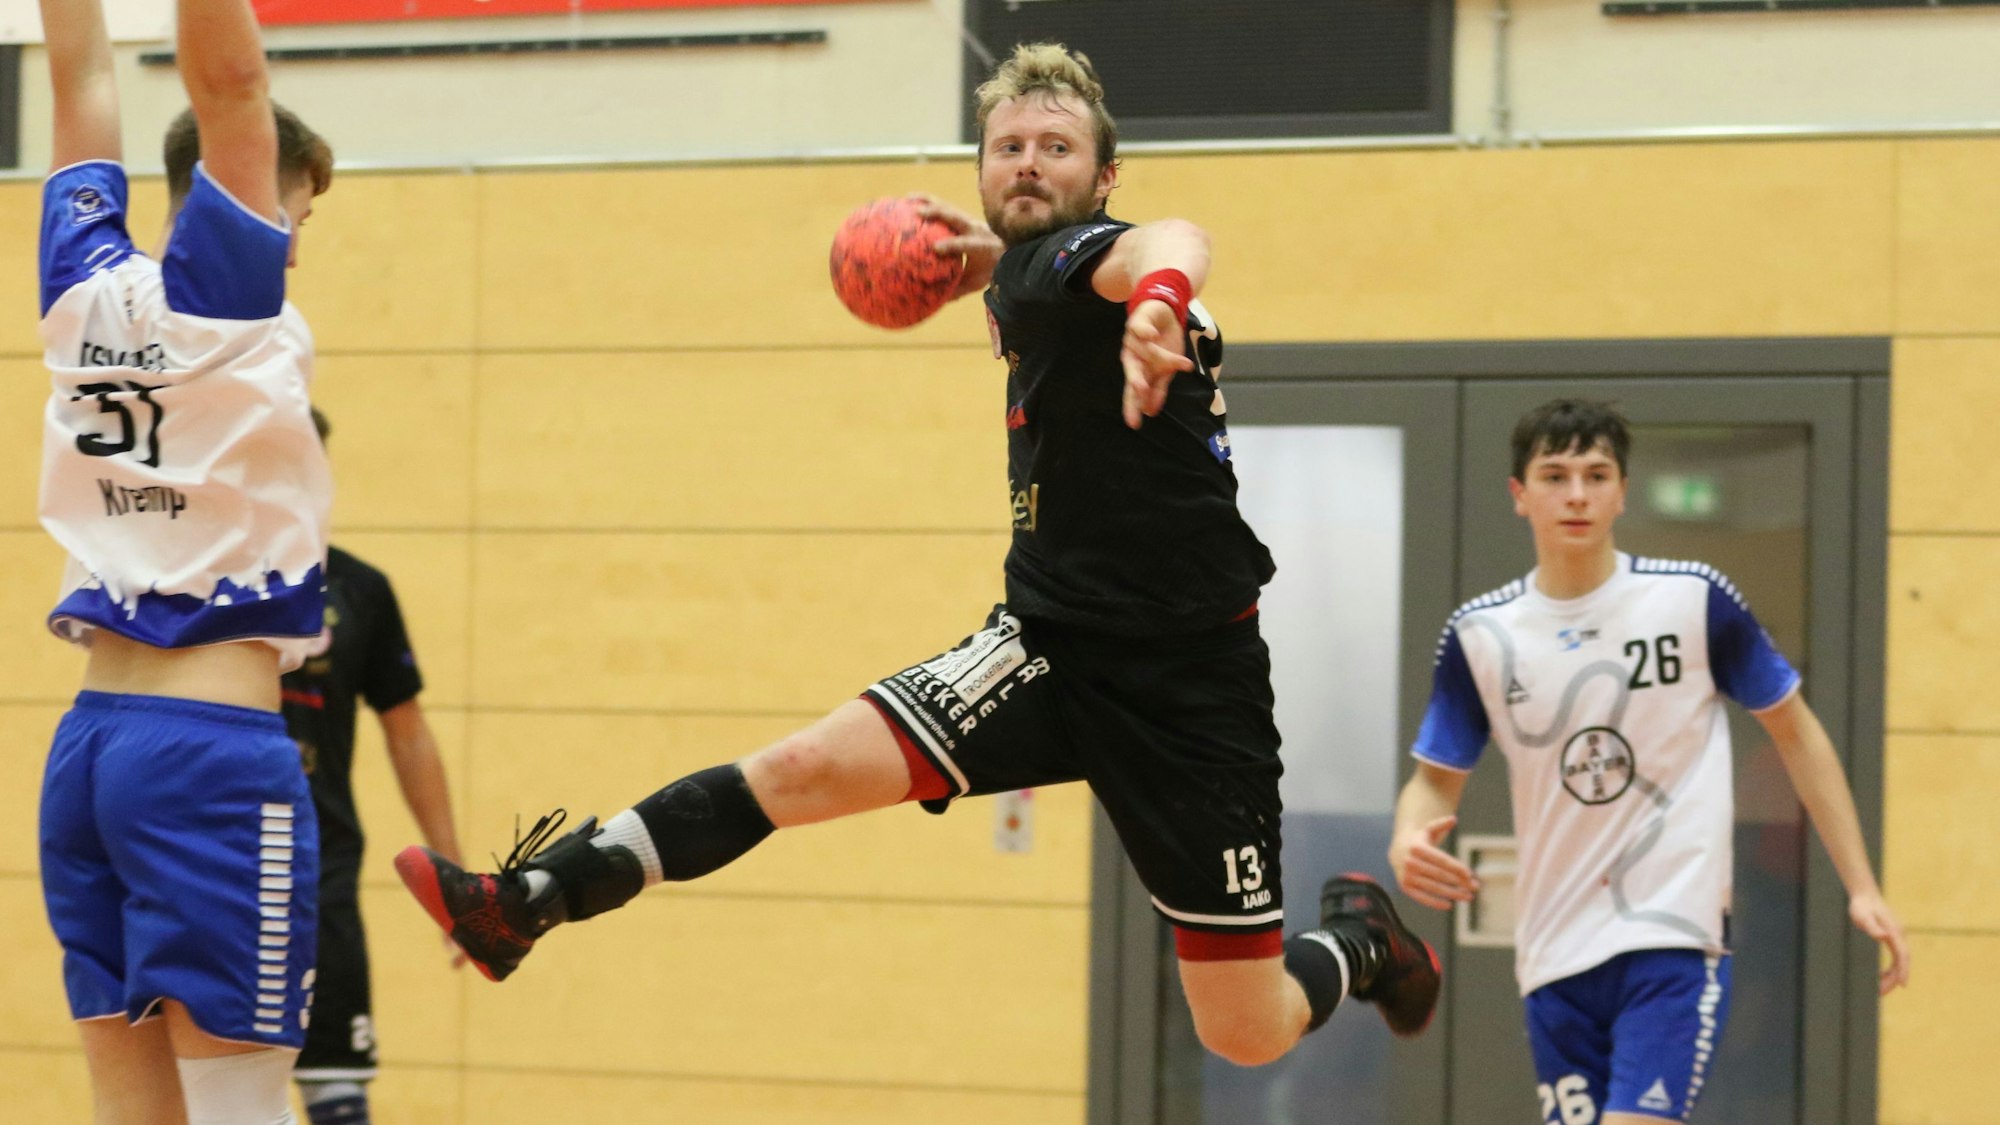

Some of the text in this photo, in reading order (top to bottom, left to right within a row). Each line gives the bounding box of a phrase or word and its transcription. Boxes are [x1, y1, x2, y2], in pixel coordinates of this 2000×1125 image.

[96, 478, 186, 519] Kremp
[962, 652, 1013, 696] TROCKENBAU
[1624, 633, 1682, 690] 26
[901, 667, 978, 736] BECKER
[1222, 845, 1262, 894] 13
[1242, 889, 1272, 910] JAKO
[1536, 1073, 1597, 1125] 26
